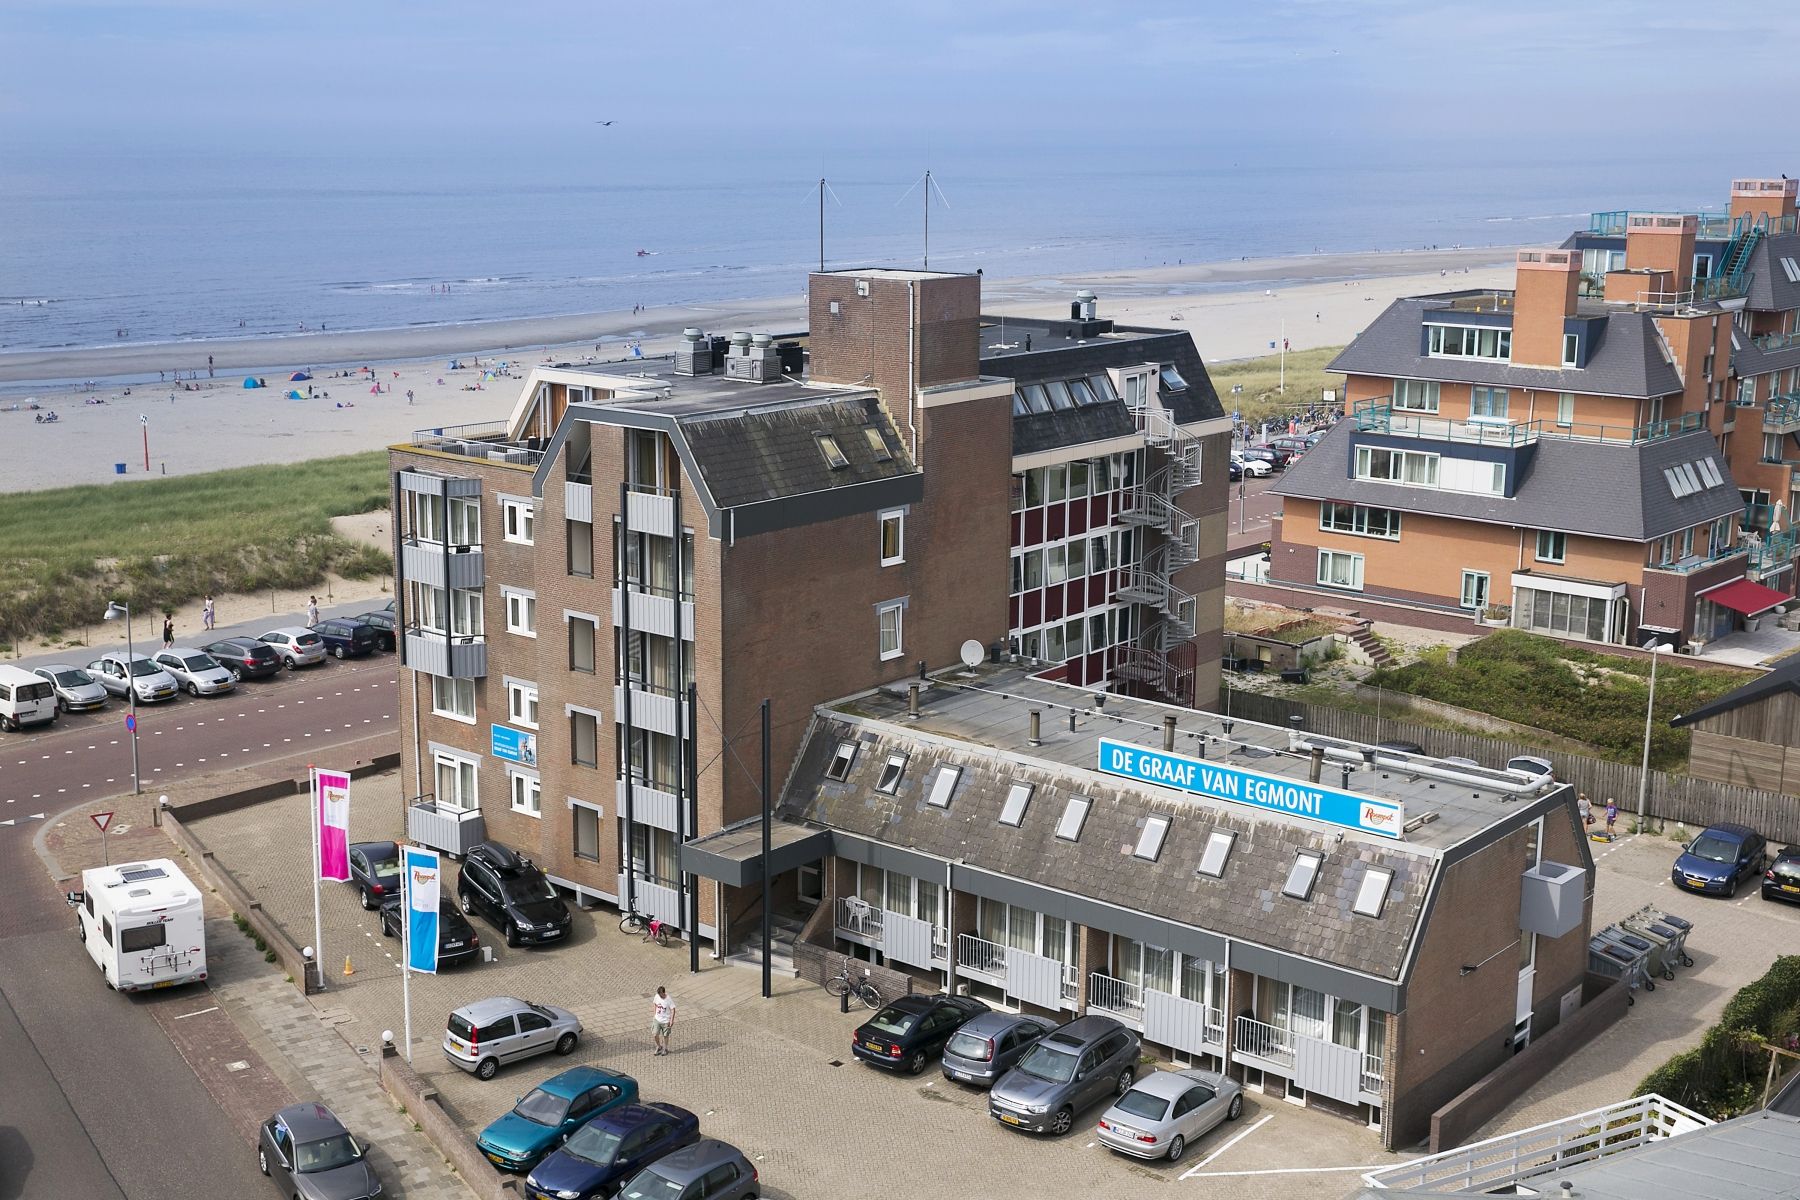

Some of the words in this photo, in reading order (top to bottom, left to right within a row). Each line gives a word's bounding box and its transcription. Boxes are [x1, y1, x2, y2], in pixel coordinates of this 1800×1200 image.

[1112, 749, 1133, 772] DE
[1139, 755, 1196, 786] GRAAF
[1202, 768, 1238, 796] VAN
[1245, 778, 1324, 815] EGMONT
